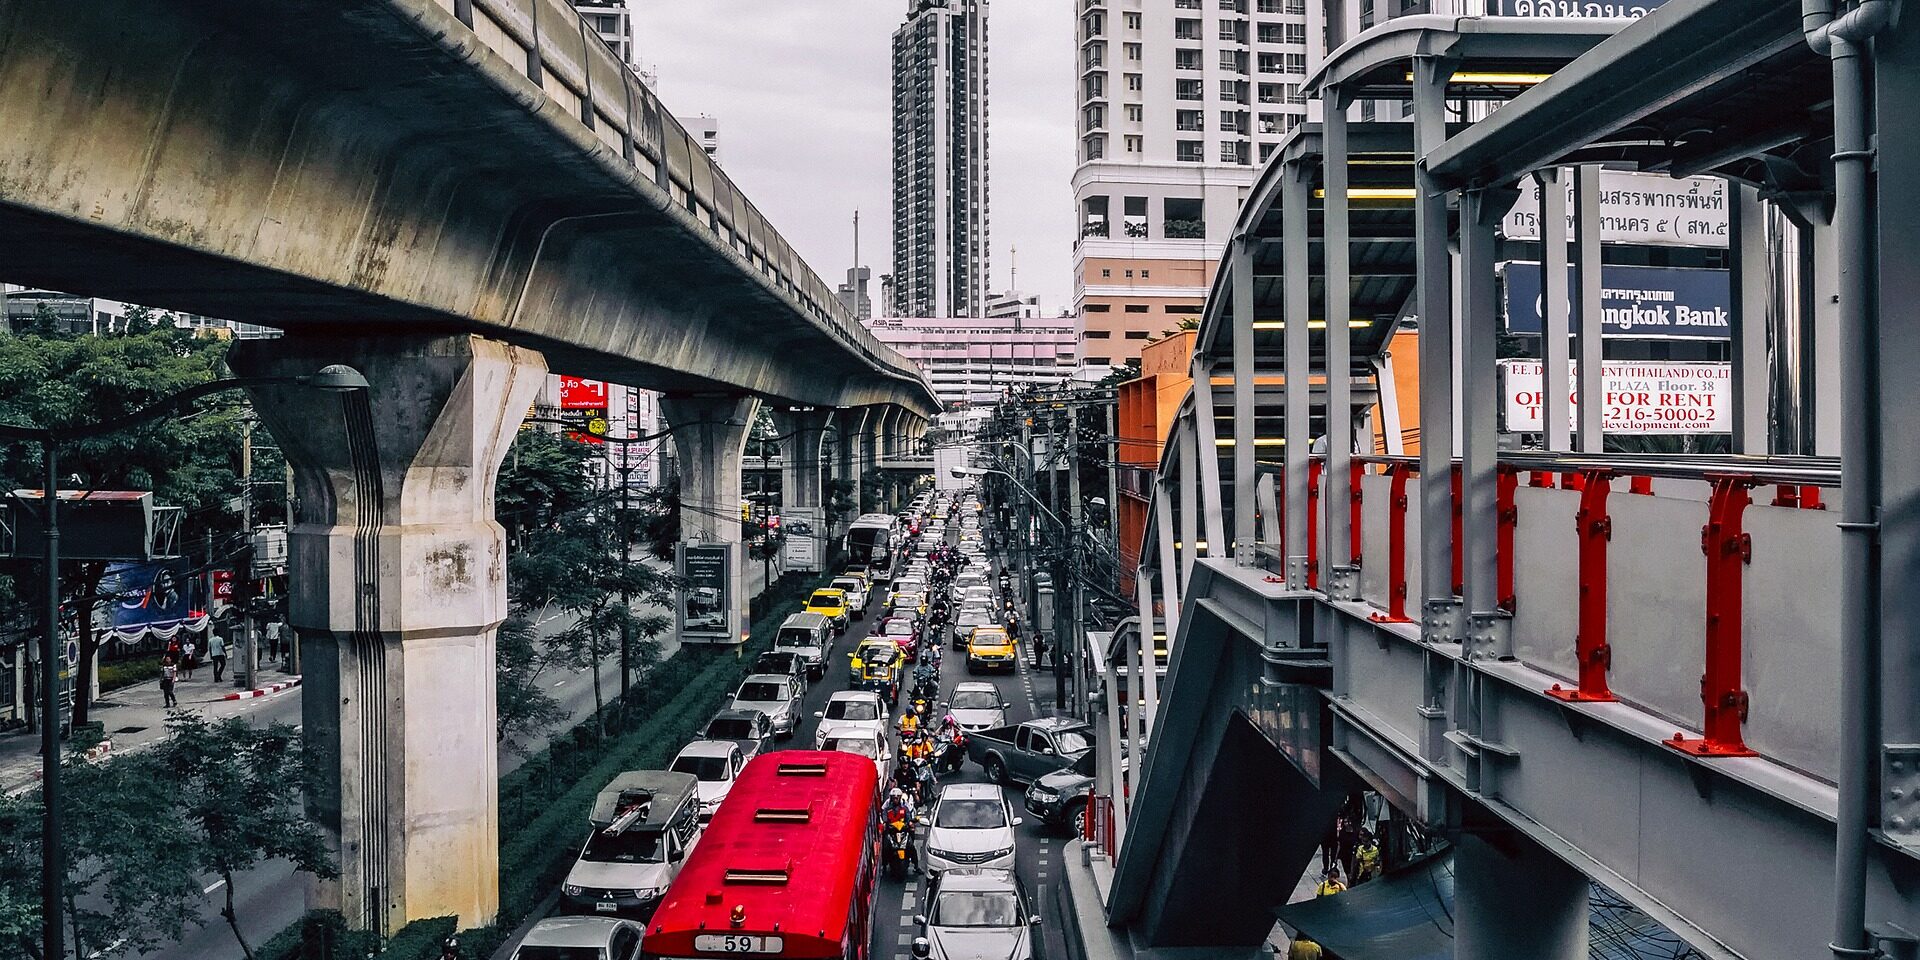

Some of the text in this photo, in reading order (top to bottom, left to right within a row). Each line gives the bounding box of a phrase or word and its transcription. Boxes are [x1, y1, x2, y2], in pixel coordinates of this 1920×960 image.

[1601, 305, 1729, 330] ngkok Bank
[1512, 365, 1530, 375] F.E.
[1609, 380, 1715, 391] PLAZA Floor. 38
[1607, 392, 1716, 406] FOR RENT
[724, 936, 751, 952] 59
